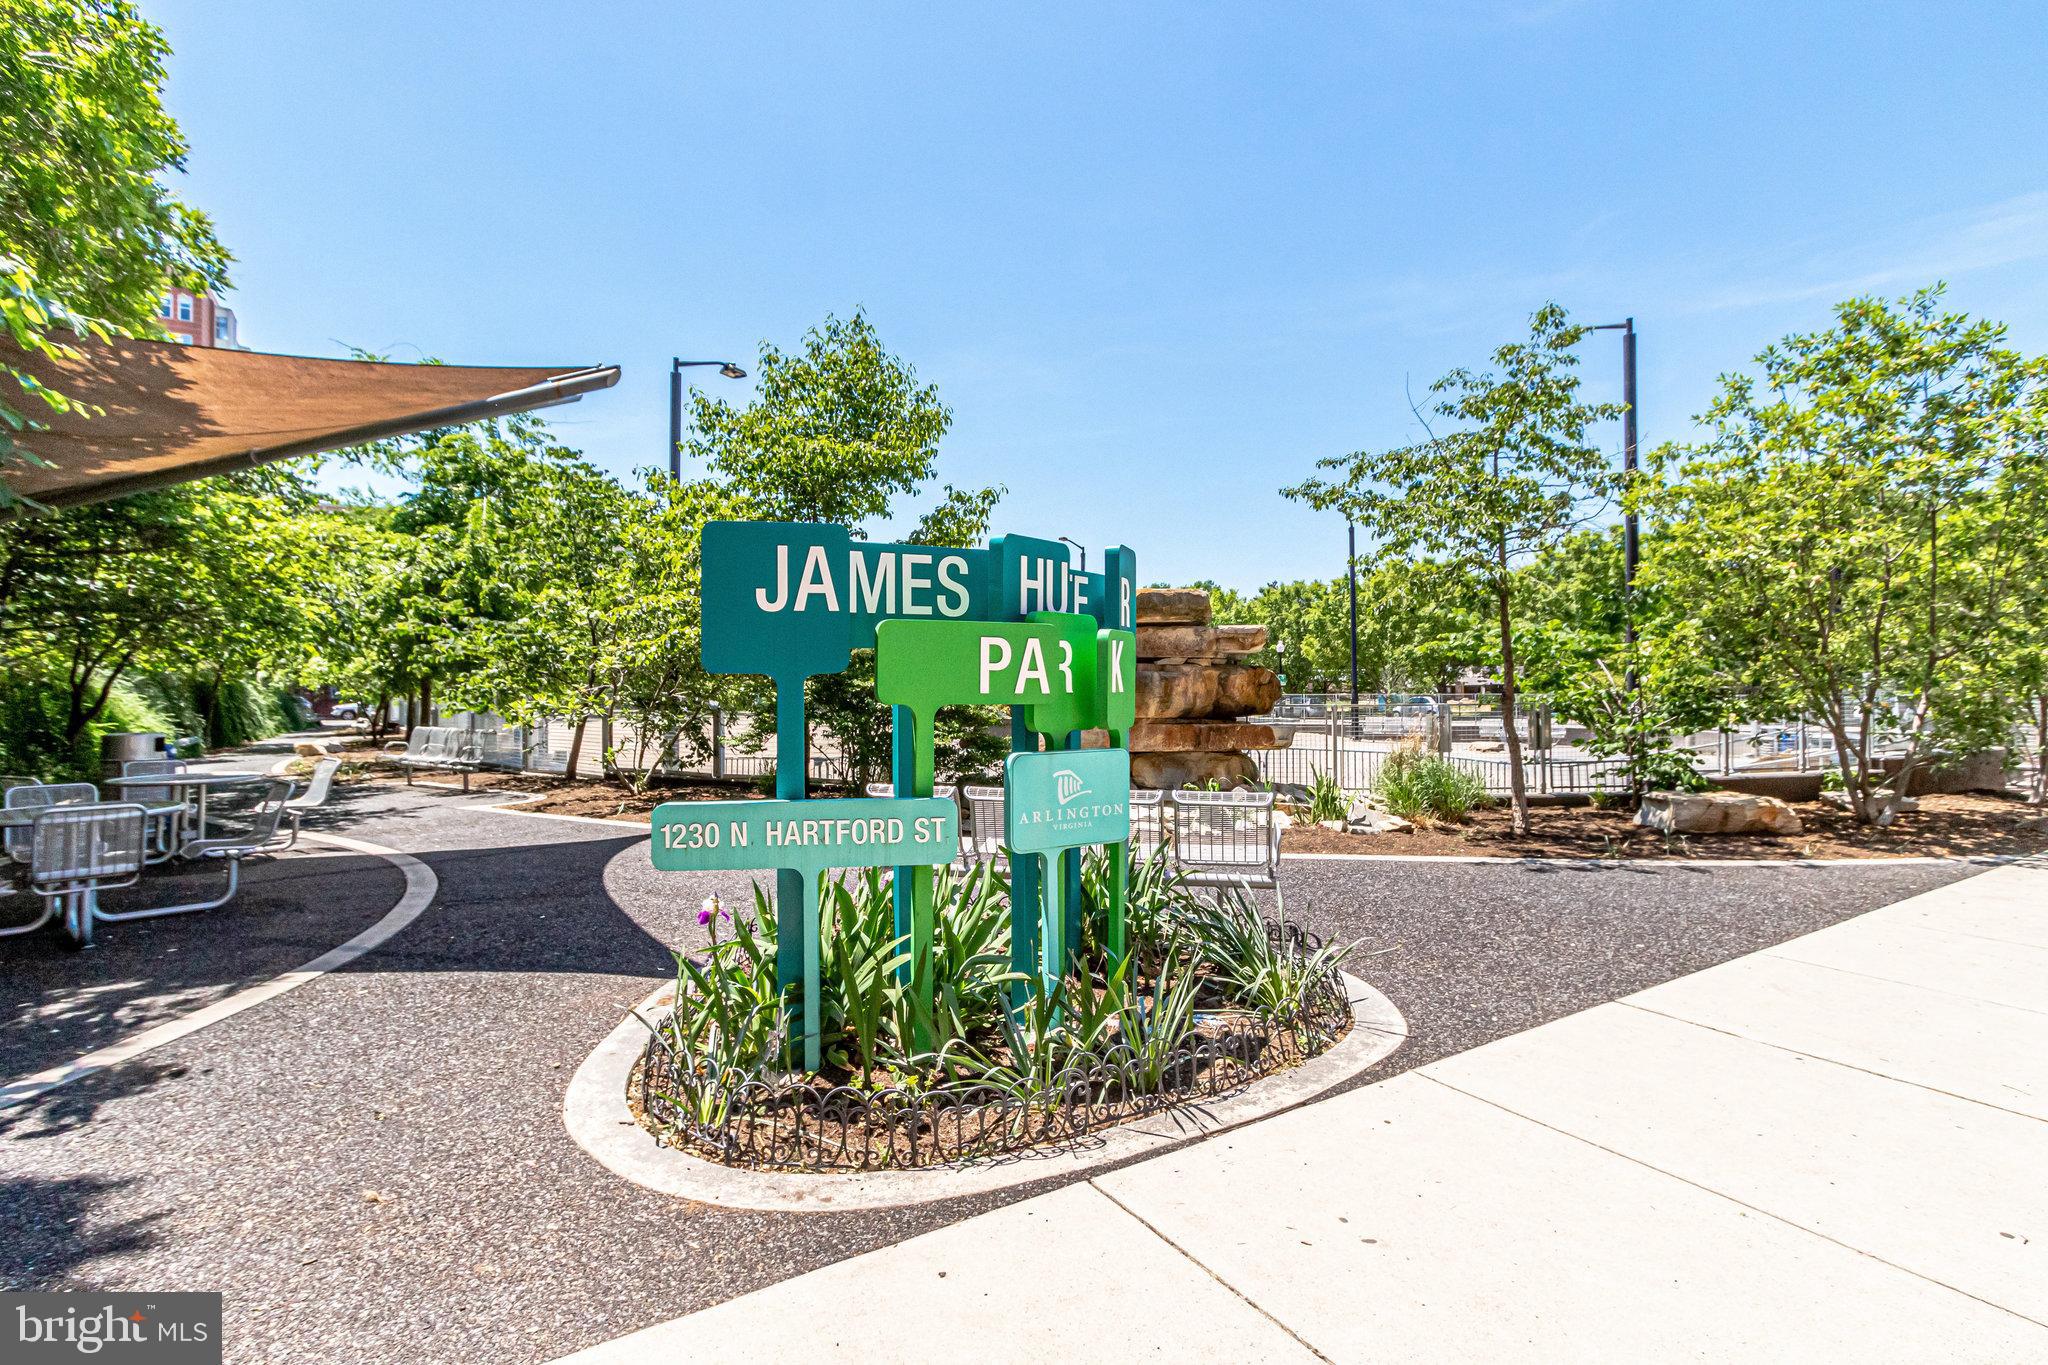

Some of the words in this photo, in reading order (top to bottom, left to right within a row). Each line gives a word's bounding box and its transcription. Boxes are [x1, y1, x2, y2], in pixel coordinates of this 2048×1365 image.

[755, 545, 970, 617] JAMES
[979, 636, 1124, 695] PARK
[1019, 803, 1123, 825] ARLINGTON
[1052, 821, 1093, 831] VIRGINIA
[660, 823, 720, 849] 1230
[730, 821, 748, 847] N
[766, 818, 904, 846] HARTFORD
[914, 817, 946, 843] ST
